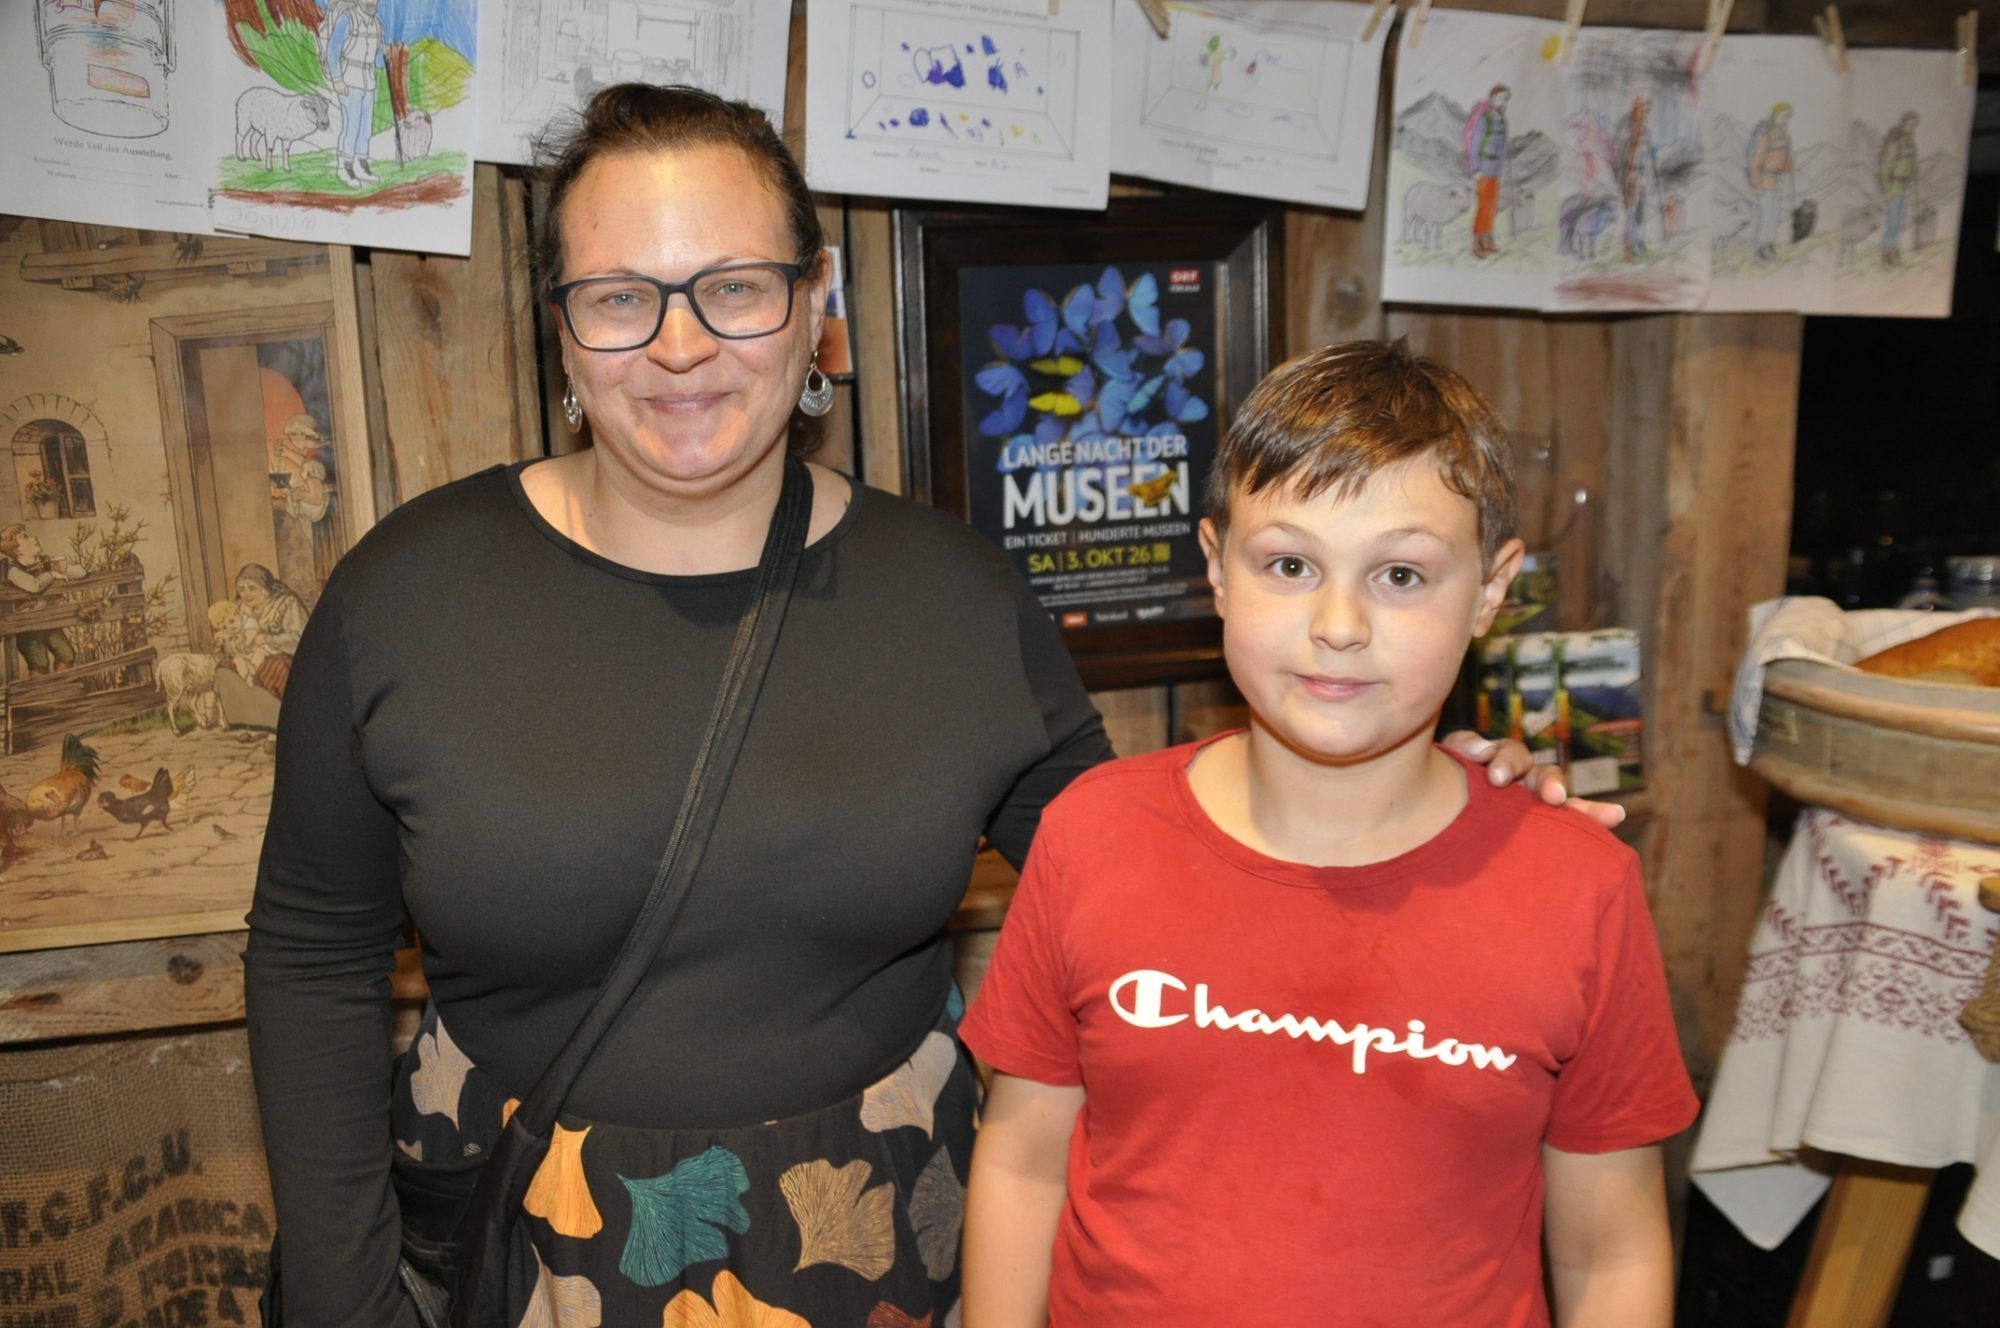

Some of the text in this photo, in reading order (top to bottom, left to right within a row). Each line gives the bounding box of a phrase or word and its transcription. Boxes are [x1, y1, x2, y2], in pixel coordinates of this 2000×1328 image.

[54, 136, 85, 149] Werde
[87, 141, 103, 151] Teil
[1003, 434, 1188, 469] LANGE NACHT DER
[1003, 461, 1190, 529] MUSEEN
[1004, 535, 1026, 549] EIN
[1027, 531, 1068, 547] TICKET
[1079, 524, 1140, 543] HUNDERTE
[1143, 521, 1191, 537] MUSEEN
[1028, 553, 1055, 573] SA
[1067, 550, 1084, 570] 3.
[1086, 546, 1125, 568] OKT
[1128, 545, 1151, 565] 26
[1109, 969, 1517, 1074] Champion
